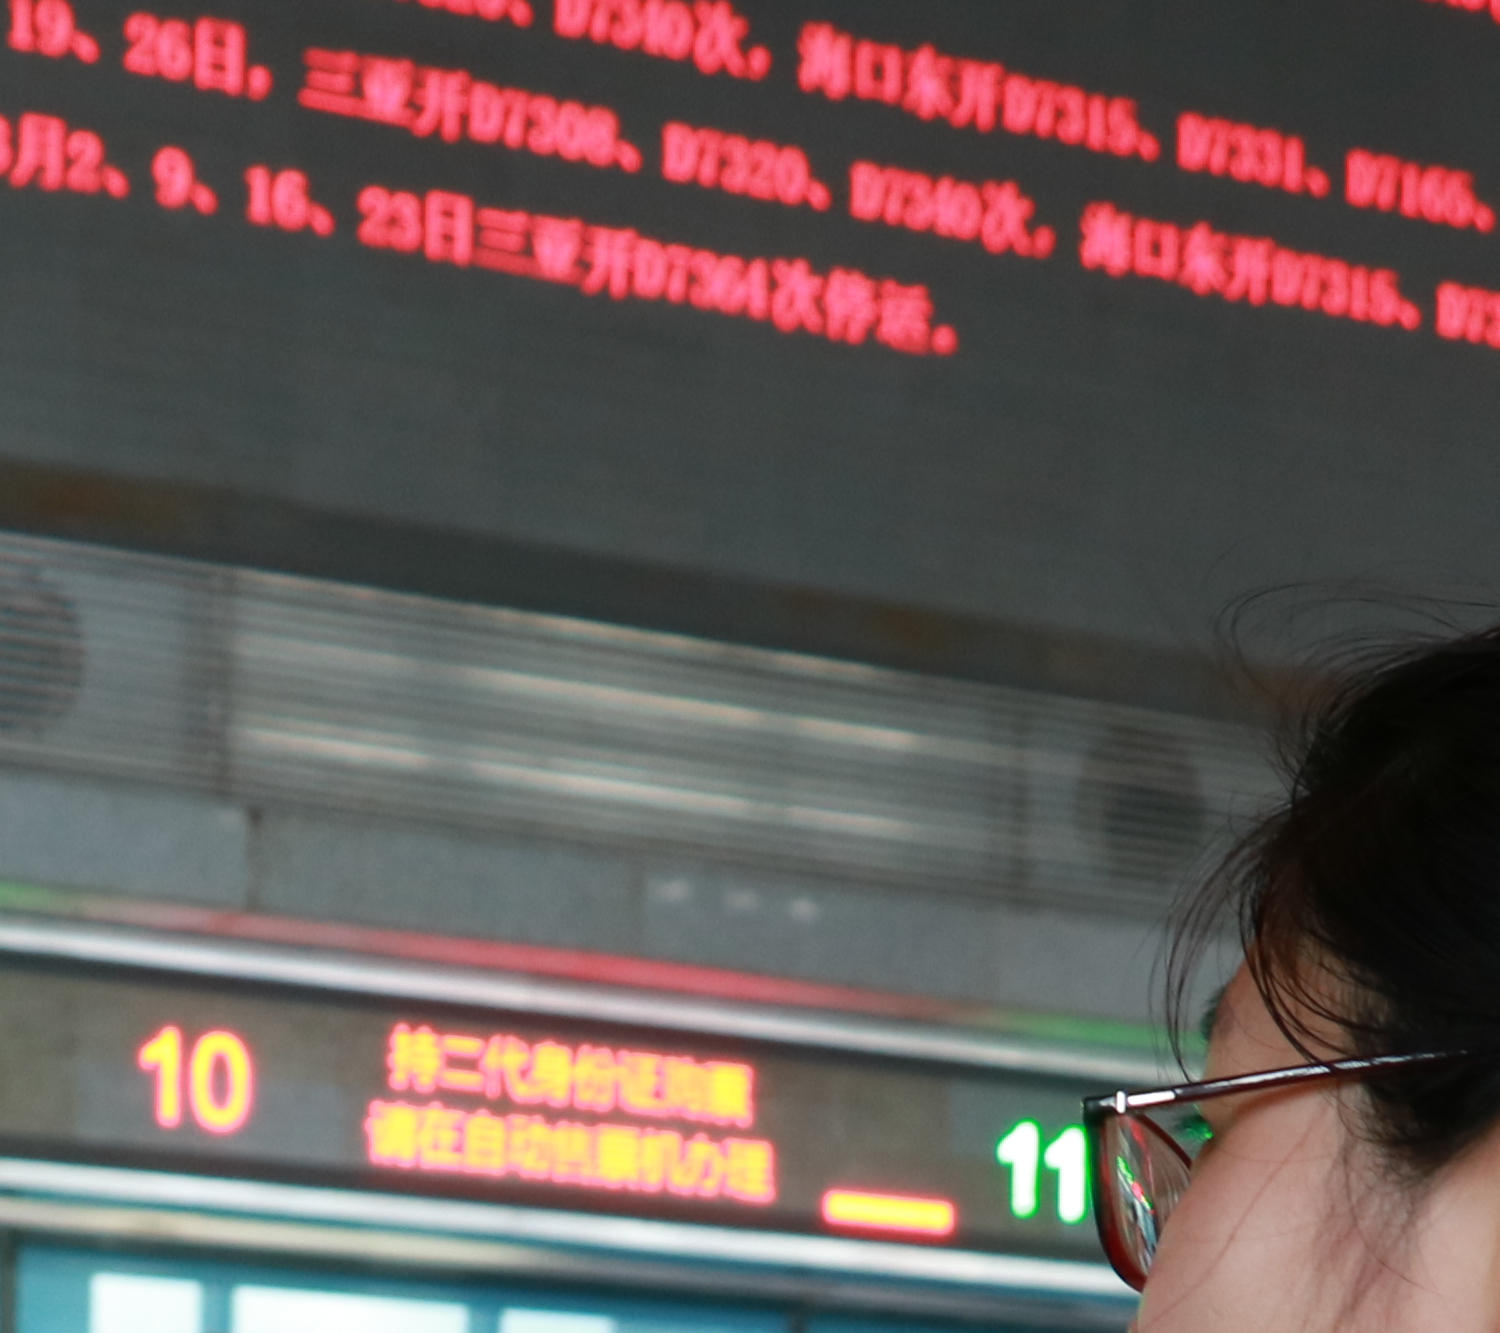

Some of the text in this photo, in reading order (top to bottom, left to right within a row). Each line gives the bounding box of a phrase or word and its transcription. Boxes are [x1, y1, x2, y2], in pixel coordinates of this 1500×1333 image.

[136, 1024, 256, 1135] 10
[388, 1022, 757, 1128] 持二代身份证购票
[363, 1100, 778, 1206] 请在自动售票机办理
[996, 1119, 1091, 1224] 11
